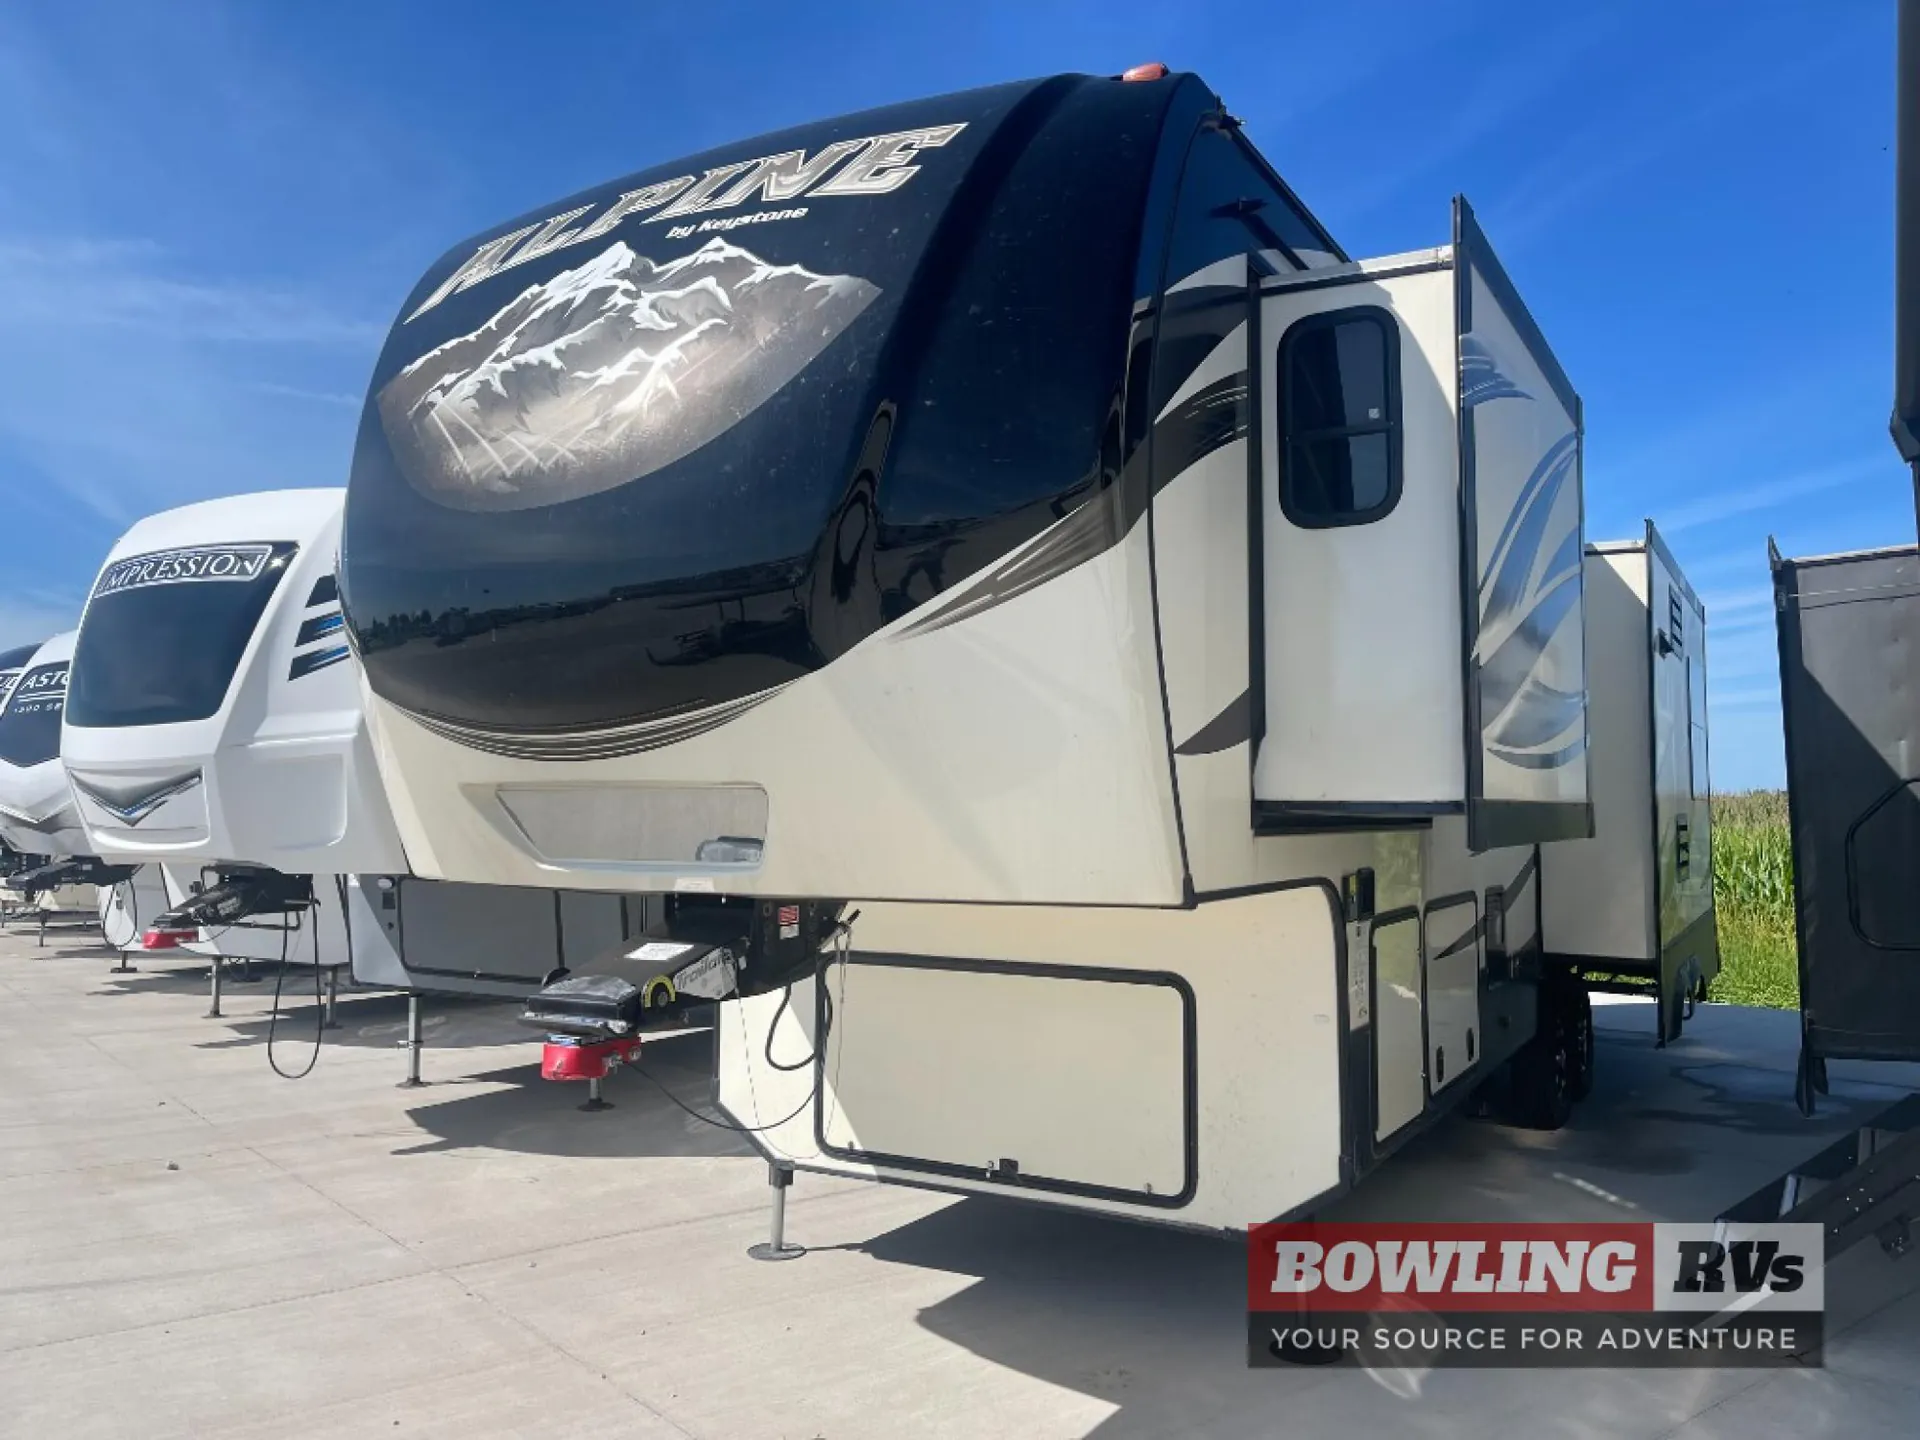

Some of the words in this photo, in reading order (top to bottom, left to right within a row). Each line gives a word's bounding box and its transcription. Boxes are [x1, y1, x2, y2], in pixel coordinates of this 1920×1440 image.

[403, 122, 969, 325] ALPINE
[665, 224, 697, 239] by
[696, 207, 809, 233] Keystone
